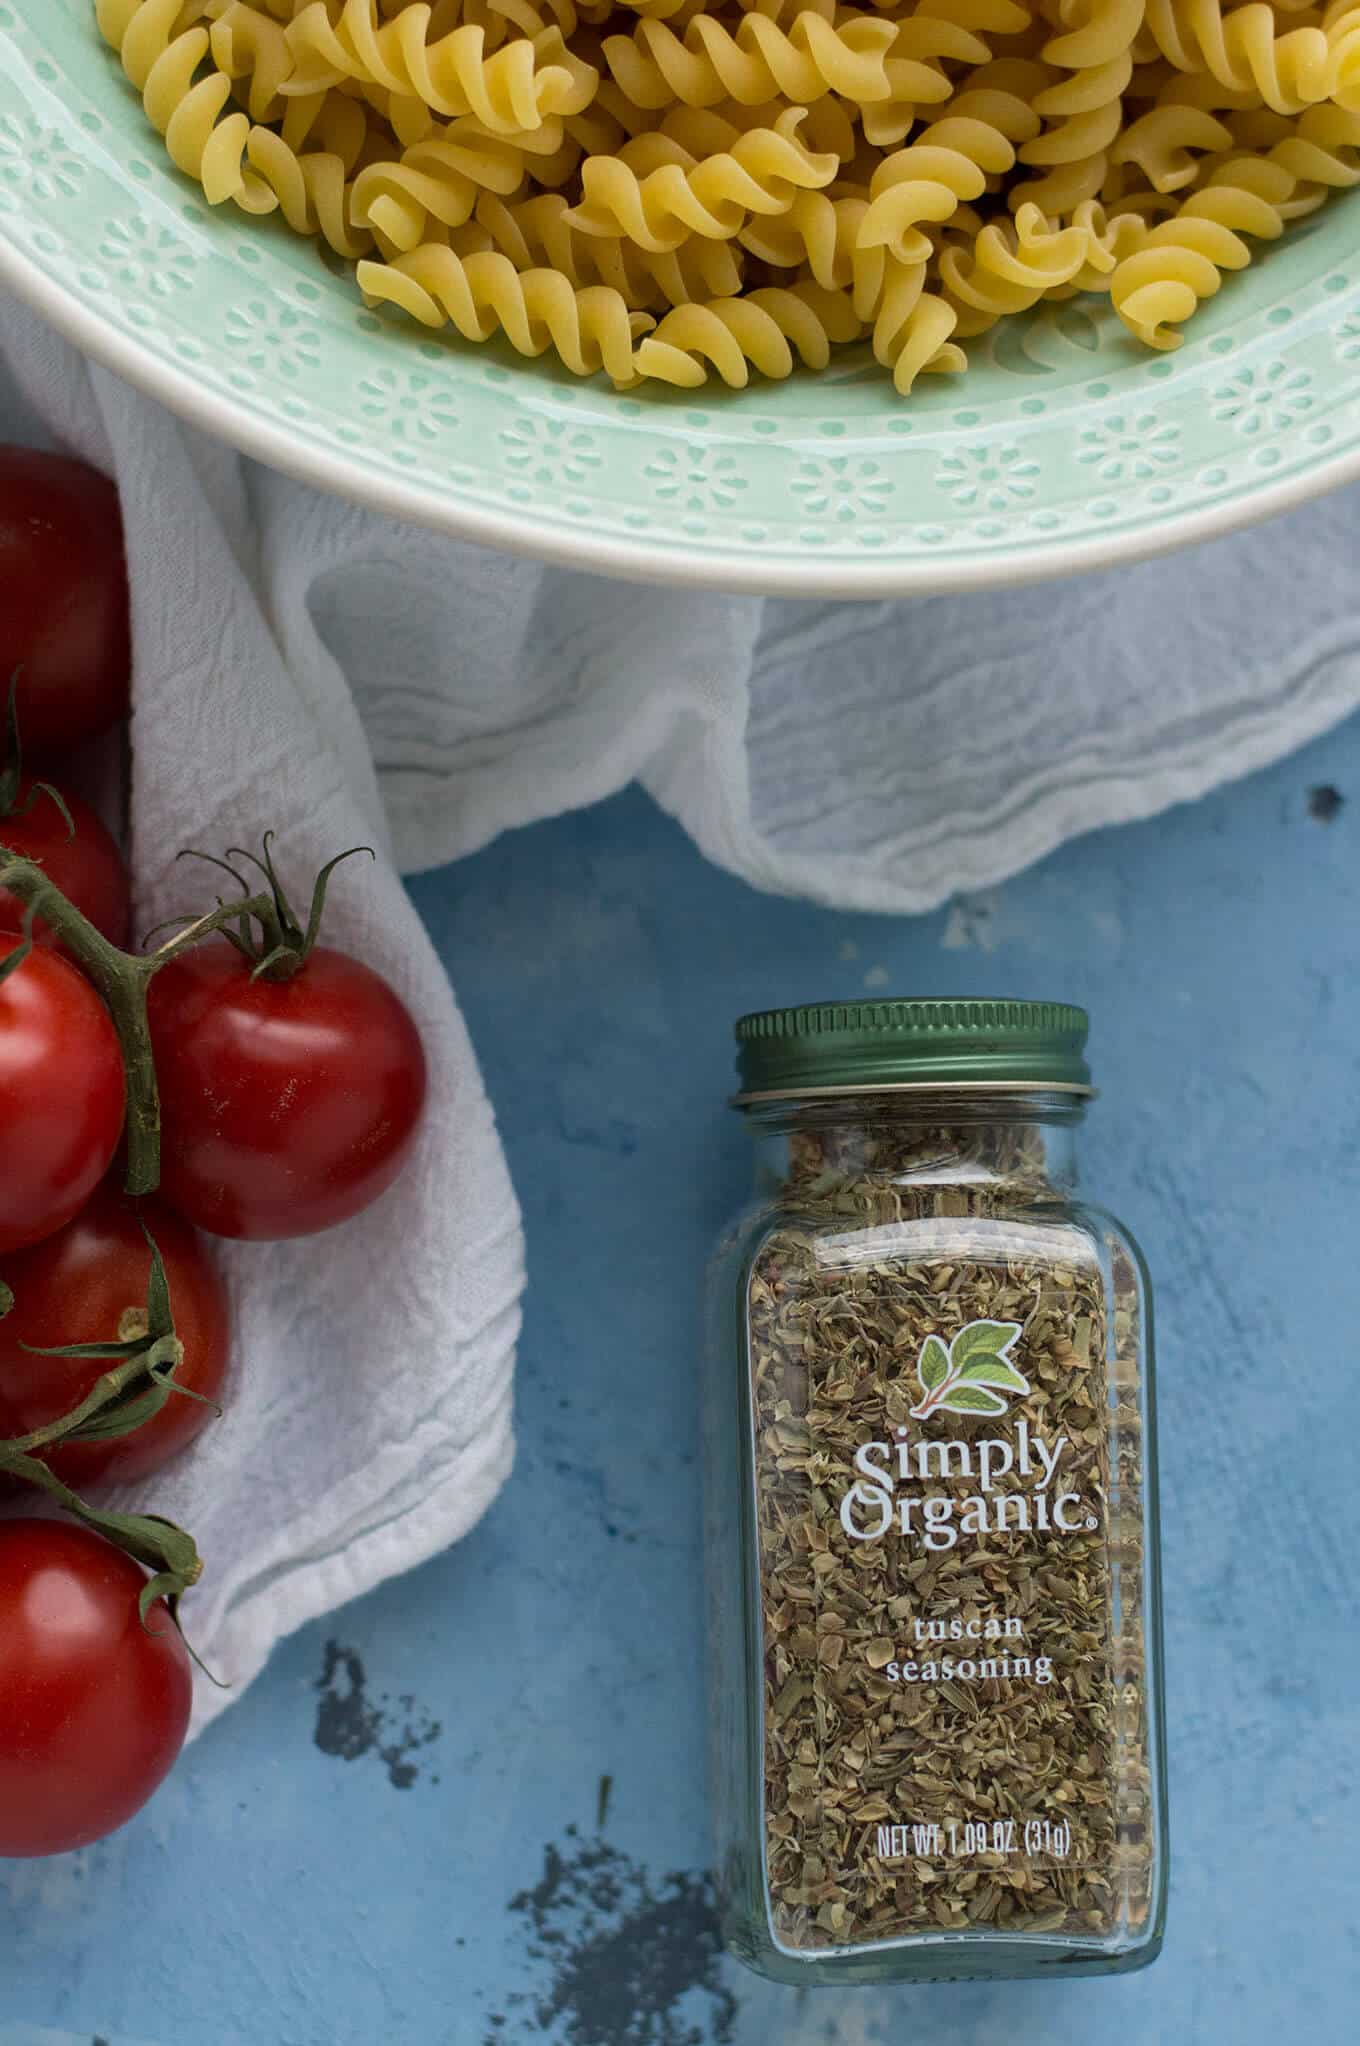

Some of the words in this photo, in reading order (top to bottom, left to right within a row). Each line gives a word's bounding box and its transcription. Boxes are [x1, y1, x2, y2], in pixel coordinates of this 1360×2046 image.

[913, 1616, 1024, 1641] tuscan
[886, 1648, 1053, 1685] seasoning
[877, 1824, 909, 1857] NET
[949, 1822, 987, 1855] 1.09
[1024, 1818, 1070, 1856] (31g)
